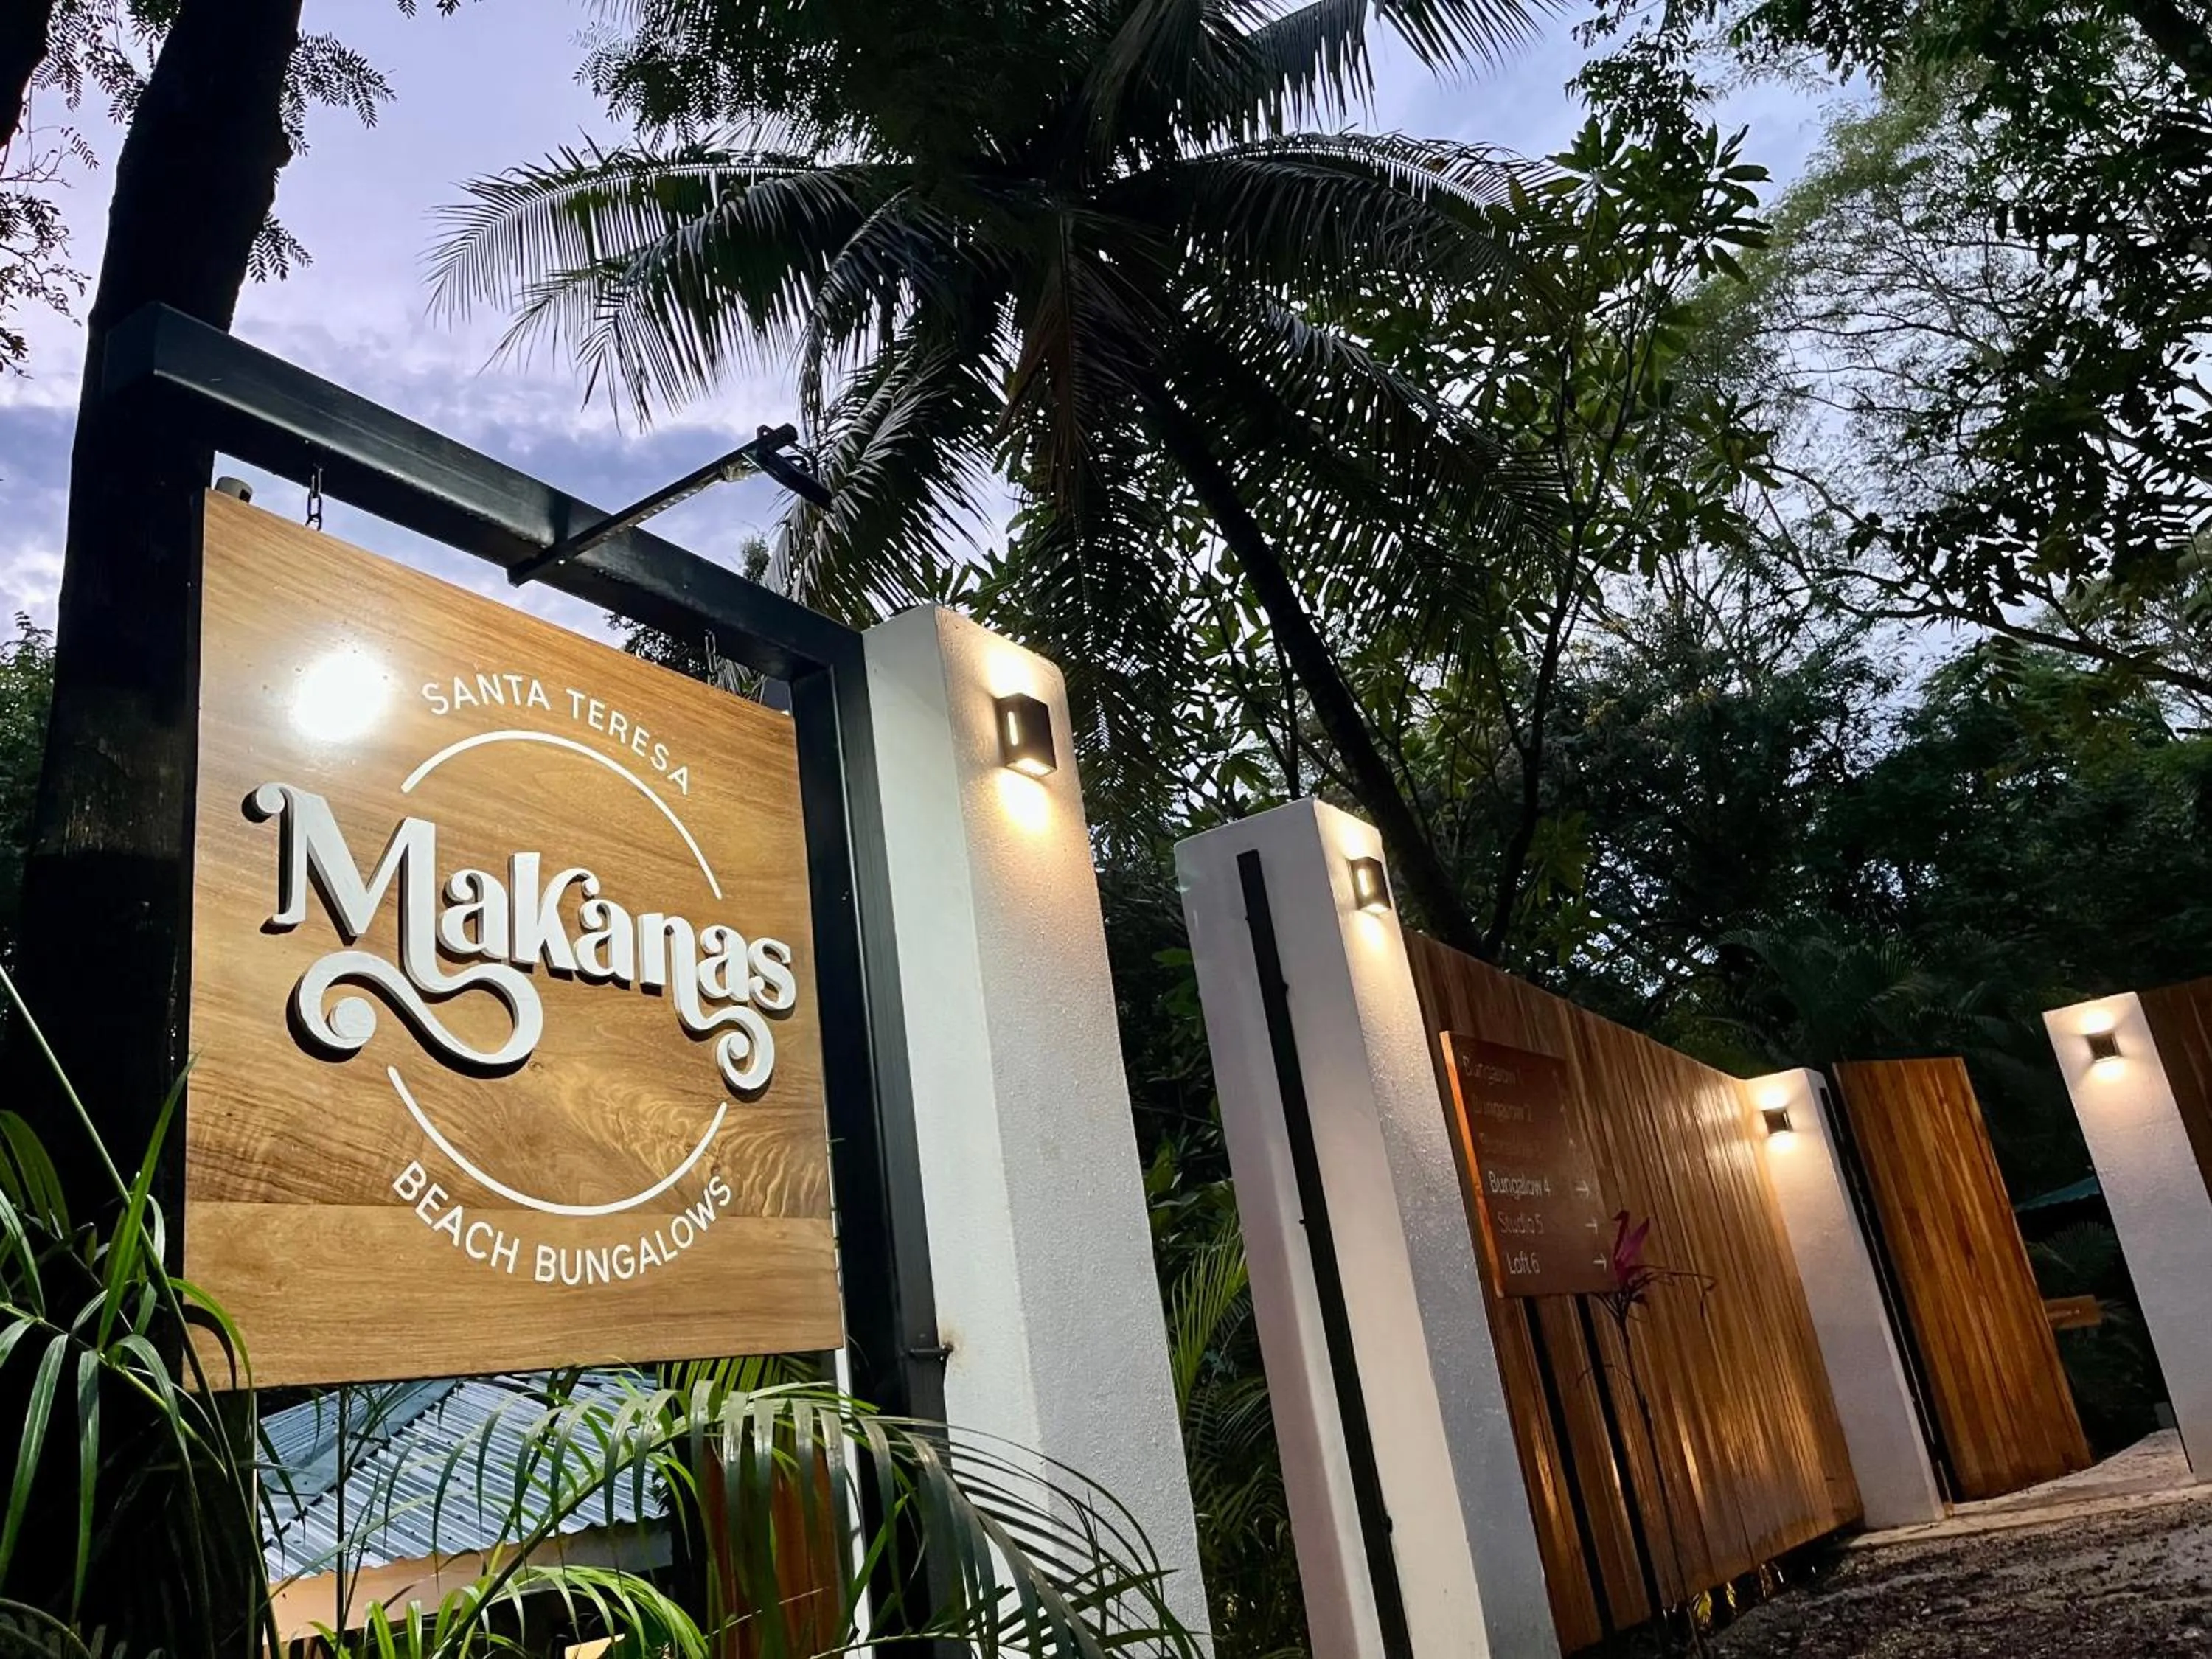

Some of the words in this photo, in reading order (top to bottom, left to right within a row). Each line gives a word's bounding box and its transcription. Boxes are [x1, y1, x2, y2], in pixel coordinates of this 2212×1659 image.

[421, 672, 552, 715] SANTA
[565, 686, 691, 796] TERESA
[245, 782, 797, 1093] Makanas
[392, 1160, 520, 1274] BEACH
[534, 1175, 732, 1285] BUNGALOWS
[1489, 1170, 1543, 1200] Bungalow
[1543, 1176, 1551, 1195] 4
[1498, 1211, 1535, 1234] Studio
[1534, 1213, 1545, 1234] 5
[1506, 1250, 1531, 1275] Loft
[1530, 1252, 1541, 1275] 6
